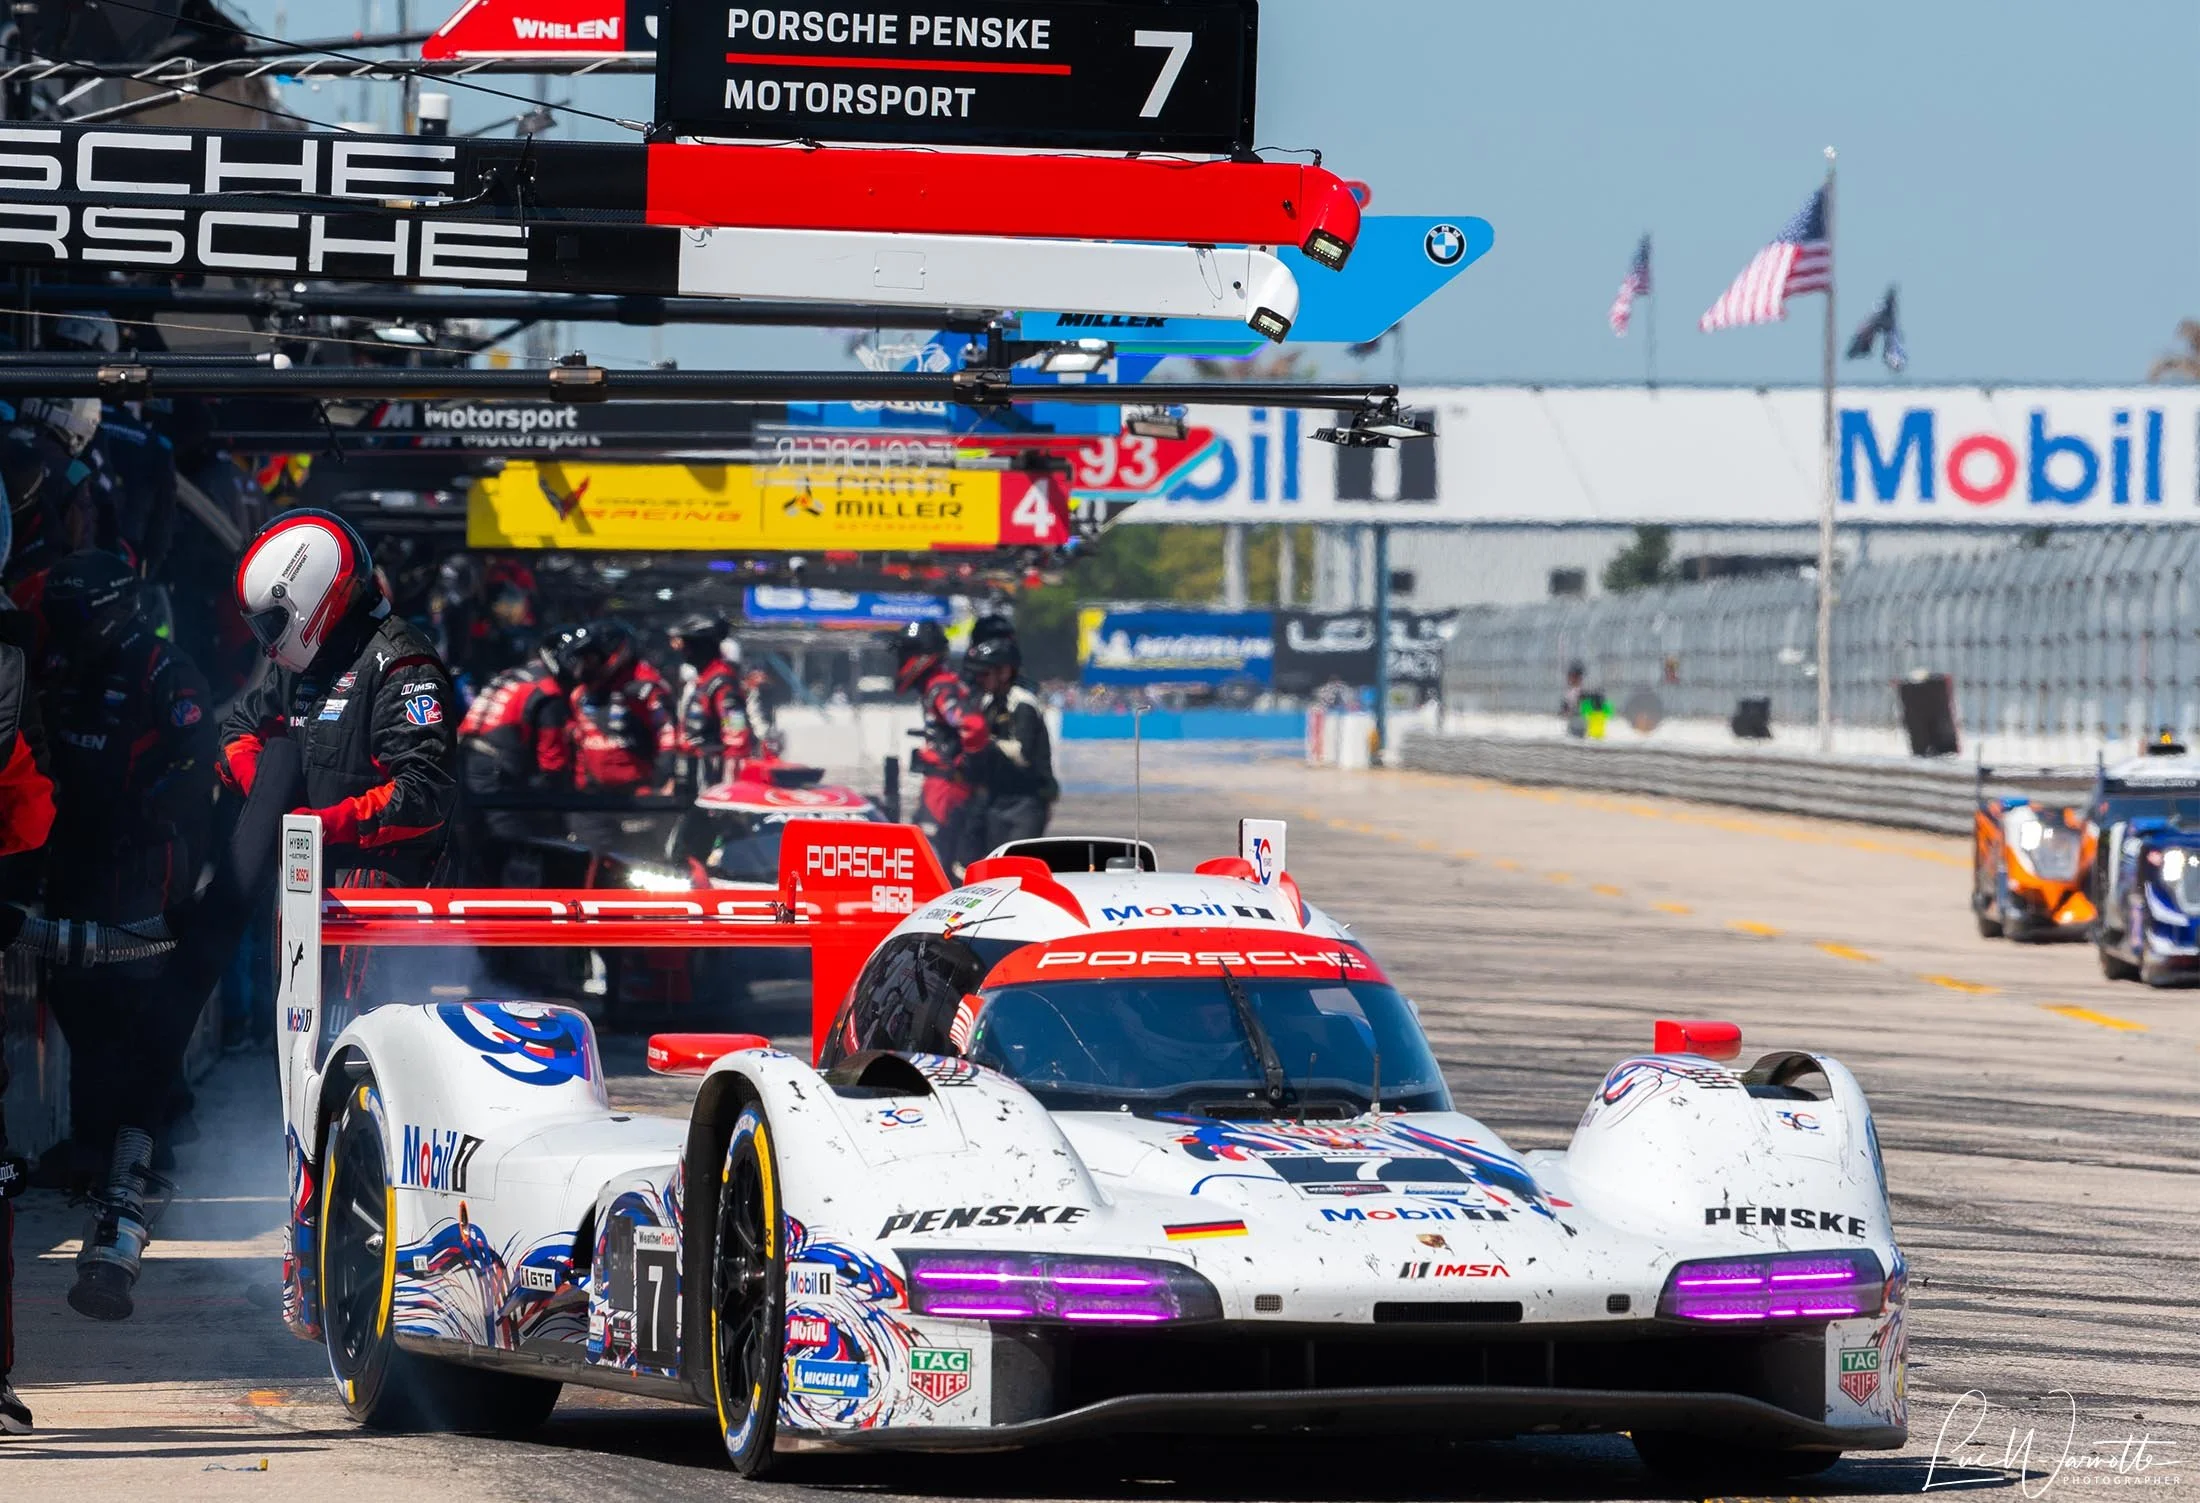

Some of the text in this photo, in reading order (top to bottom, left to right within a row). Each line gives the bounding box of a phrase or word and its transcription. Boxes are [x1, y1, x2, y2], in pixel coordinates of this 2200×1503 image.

[512, 17, 620, 40] WHELEN
[727, 8, 1051, 51] PORSCHE PENSKE
[1133, 30, 1193, 118] 7
[724, 78, 976, 118] MOTORSPORT
[0, 203, 529, 282] RSCHE
[425, 403, 577, 433] Motorsport
[1080, 435, 1159, 488] 93
[1839, 408, 2164, 506] Mobil
[835, 500, 964, 519] MILLER
[1011, 478, 1056, 538] 4
[404, 694, 434, 726] VP
[806, 845, 914, 880] PORSCHE
[871, 885, 914, 914] 963
[1101, 903, 1227, 921] Mobil
[1036, 950, 1367, 969] PORSCHE
[401, 1124, 485, 1193] Mobil 1
[1322, 1157, 1392, 1182] 7
[875, 1205, 1090, 1240] PENSKE
[1320, 1208, 1456, 1222] Mobil
[1705, 1207, 1866, 1239] PENSKE
[638, 1232, 675, 1246] WeatherTech
[530, 1271, 553, 1287] GTP
[790, 1270, 817, 1295] Mobil
[1434, 1264, 1511, 1278] IMSA
[648, 1265, 664, 1352] 7
[790, 1319, 827, 1343] MOTUL
[914, 1352, 965, 1371] TAG
[1844, 1352, 1878, 1370] TAG
[803, 1370, 860, 1388] MICHELIN
[912, 1373, 967, 1400] HEUER
[1843, 1374, 1878, 1399] HEUER
